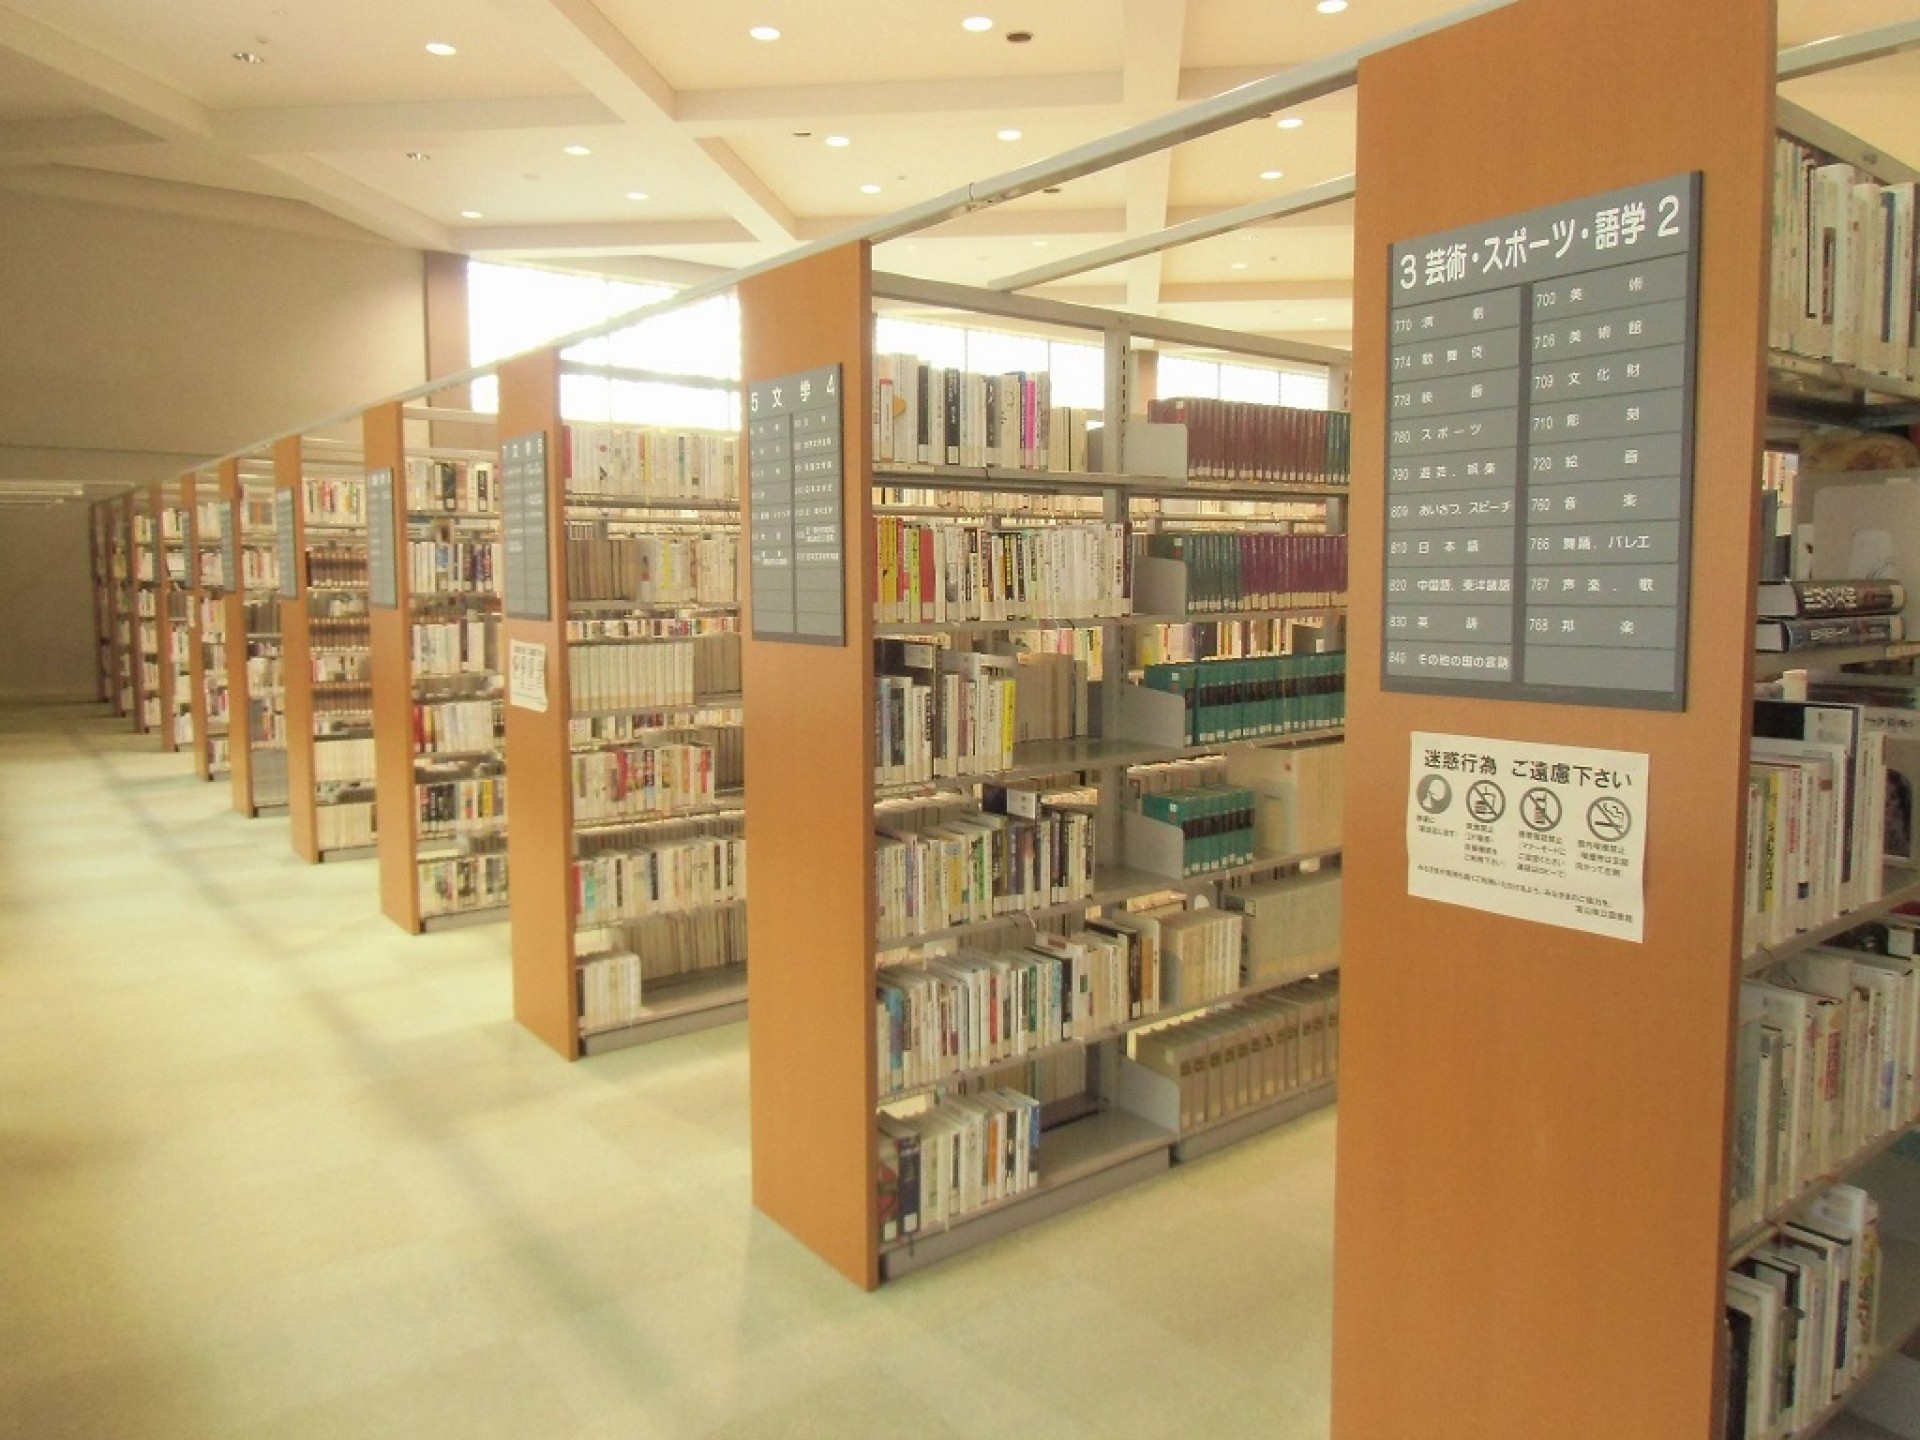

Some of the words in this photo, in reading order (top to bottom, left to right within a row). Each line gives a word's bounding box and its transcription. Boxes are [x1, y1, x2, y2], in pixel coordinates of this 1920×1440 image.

[1400, 254, 1417, 289] 3
[1424, 201, 1646, 286] 芸術・スポーツ・語学
[1657, 194, 1680, 237] 2
[751, 391, 759, 413] 5
[826, 374, 835, 396] 4
[1421, 423, 1482, 441] スポーツ
[1468, 500, 1512, 514] スピーチ
[1607, 535, 1651, 549] バレエ
[1424, 749, 1497, 776] 迷惑行為
[1511, 759, 1632, 789] ご遠慮下さい
